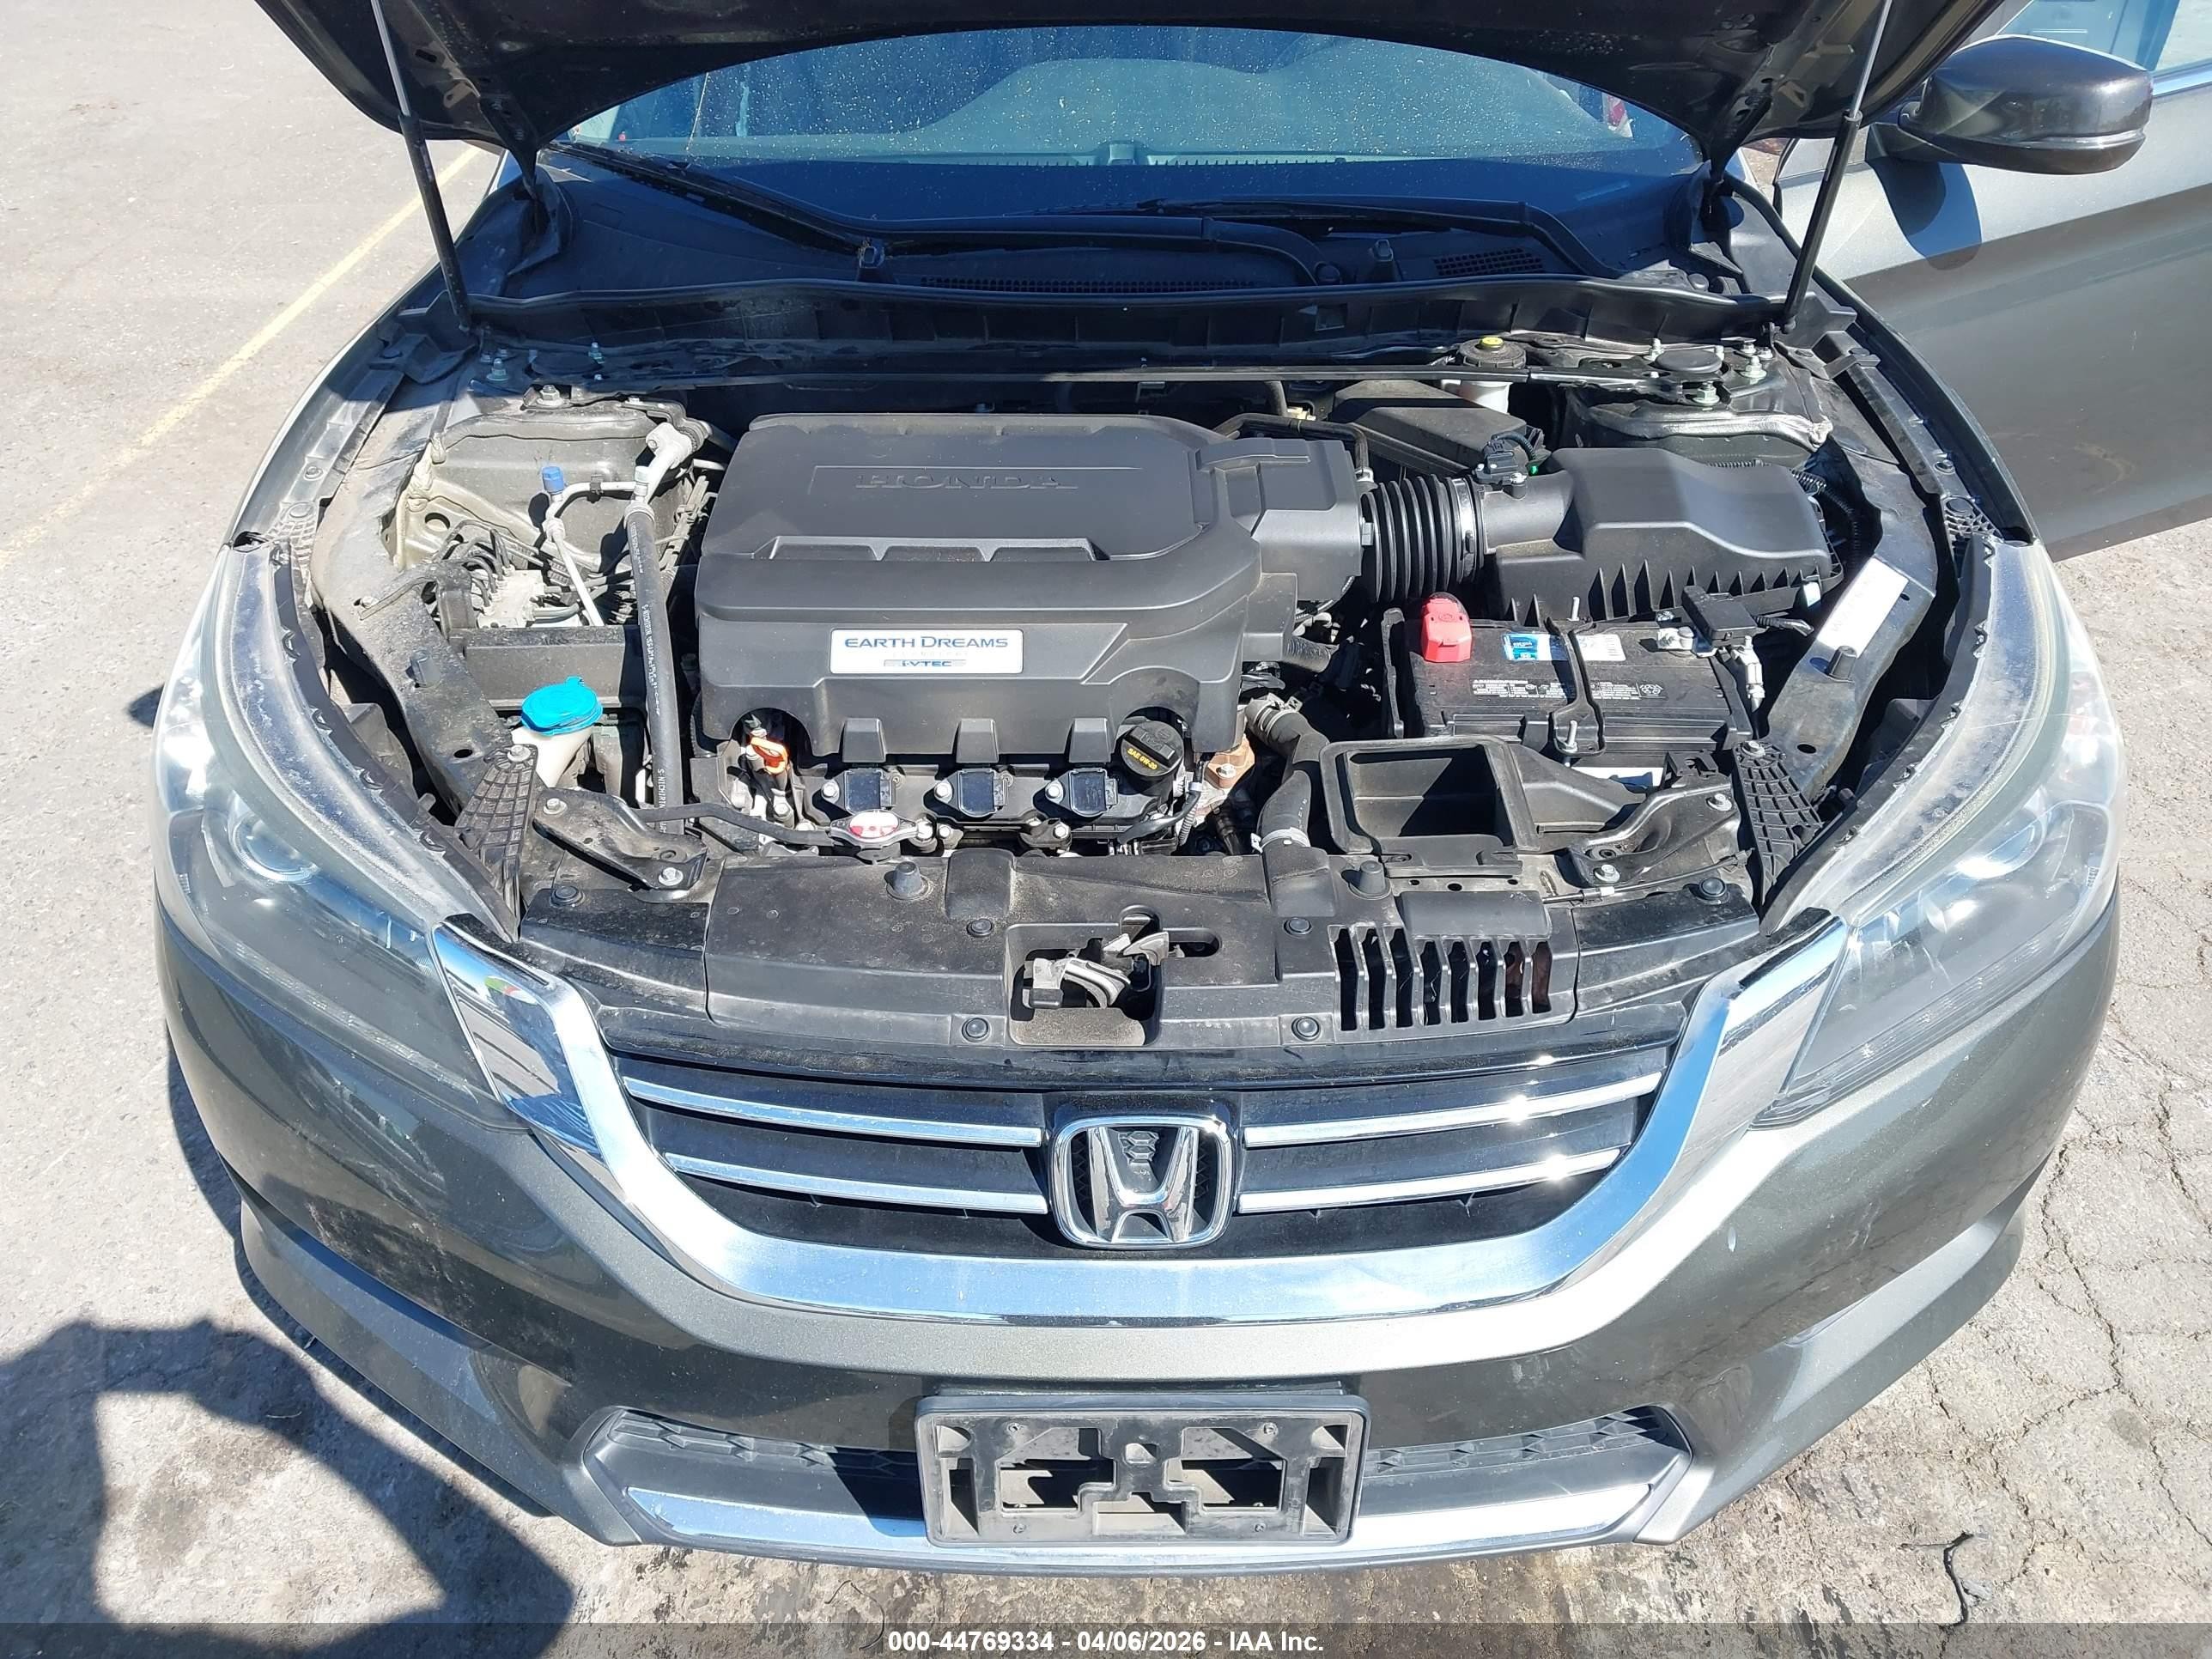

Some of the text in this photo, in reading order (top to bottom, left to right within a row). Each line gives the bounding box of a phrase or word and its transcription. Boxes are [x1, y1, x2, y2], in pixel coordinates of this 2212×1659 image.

[855, 474, 1079, 489] HONDA
[844, 635, 1008, 648] EARTH DREAMS
[657, 769, 667, 808] S-NICHIRIN
